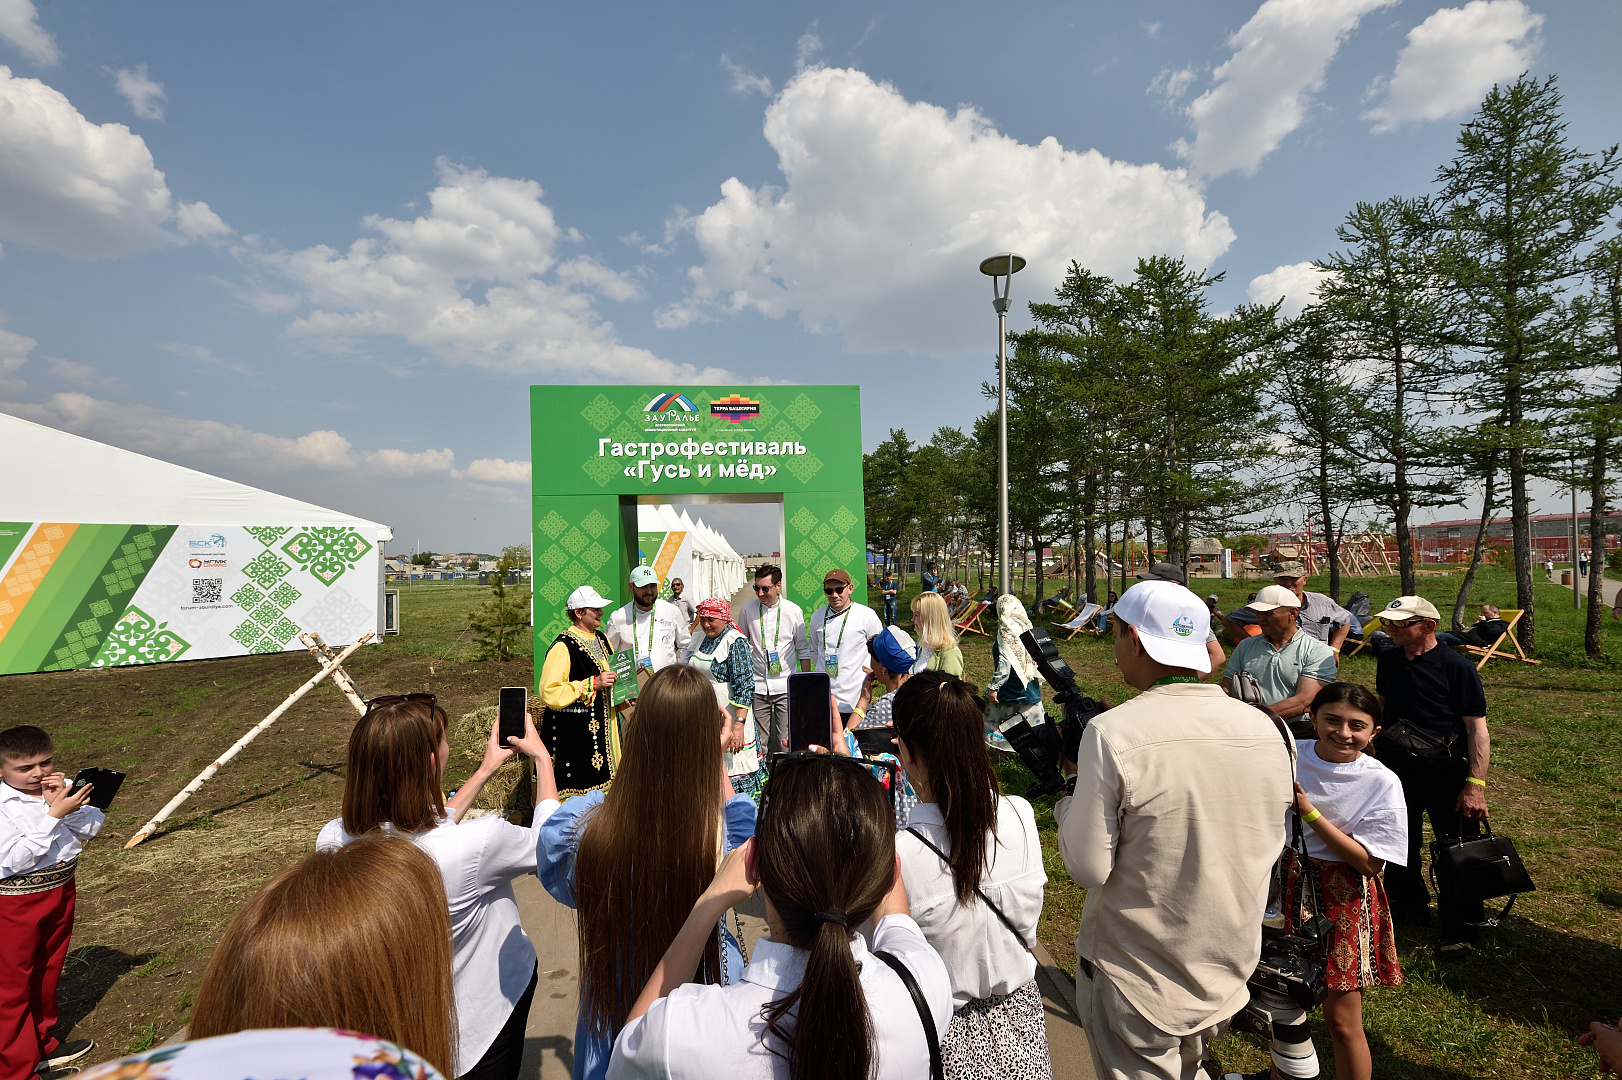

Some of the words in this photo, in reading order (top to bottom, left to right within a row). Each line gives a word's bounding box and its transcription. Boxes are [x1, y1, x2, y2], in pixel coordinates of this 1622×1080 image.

[644, 410, 700, 422] ЗАУРАЛЬЕ
[598, 437, 807, 461] Гастрофестиваль
[623, 460, 691, 483] «Гусь
[697, 464, 712, 478] и
[718, 458, 777, 480] мёд»
